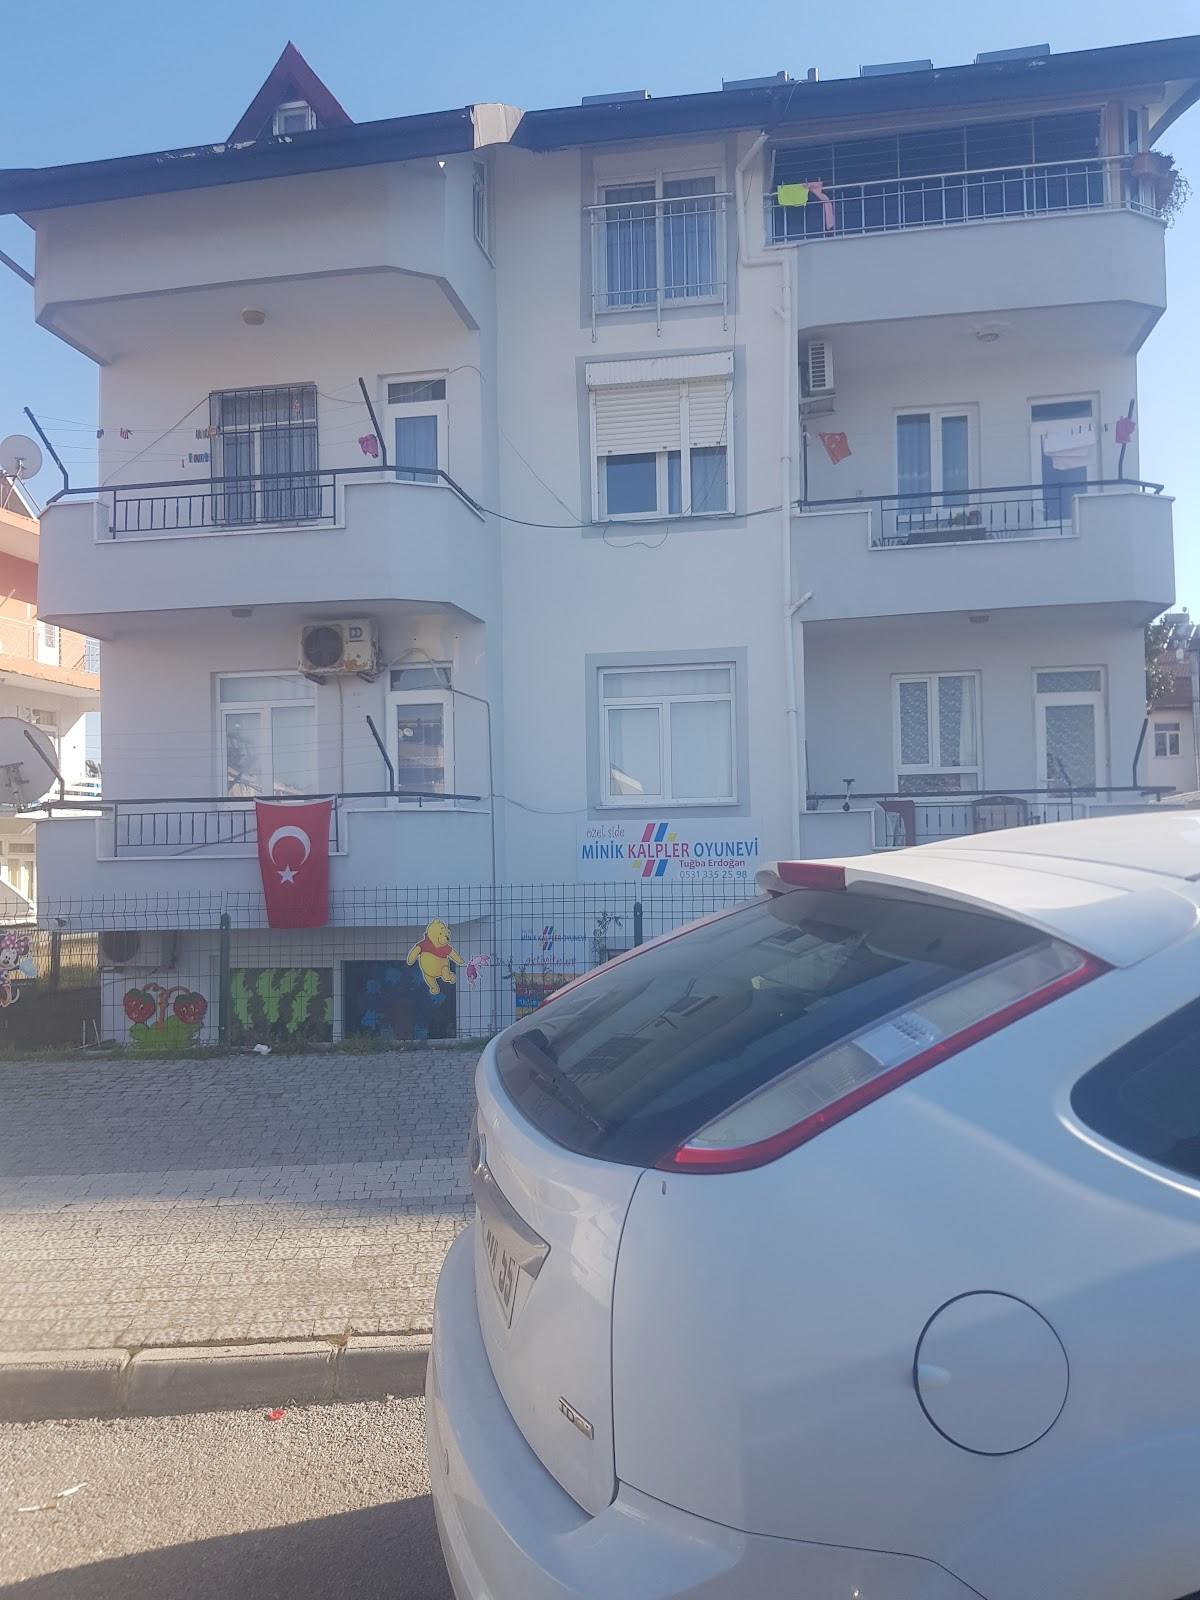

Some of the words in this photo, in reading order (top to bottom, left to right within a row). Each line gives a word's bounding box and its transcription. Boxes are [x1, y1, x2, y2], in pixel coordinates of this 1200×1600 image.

[582, 840, 624, 859] MİNİK
[628, 843, 690, 859] KALPLER
[693, 837, 758, 857] OYUNEVİ
[679, 859, 706, 869] Tuğba
[708, 859, 746, 869] Erdoğan
[679, 870, 700, 879] 0531
[703, 870, 719, 879] 335
[722, 870, 733, 879] 25
[736, 870, 748, 879] 98
